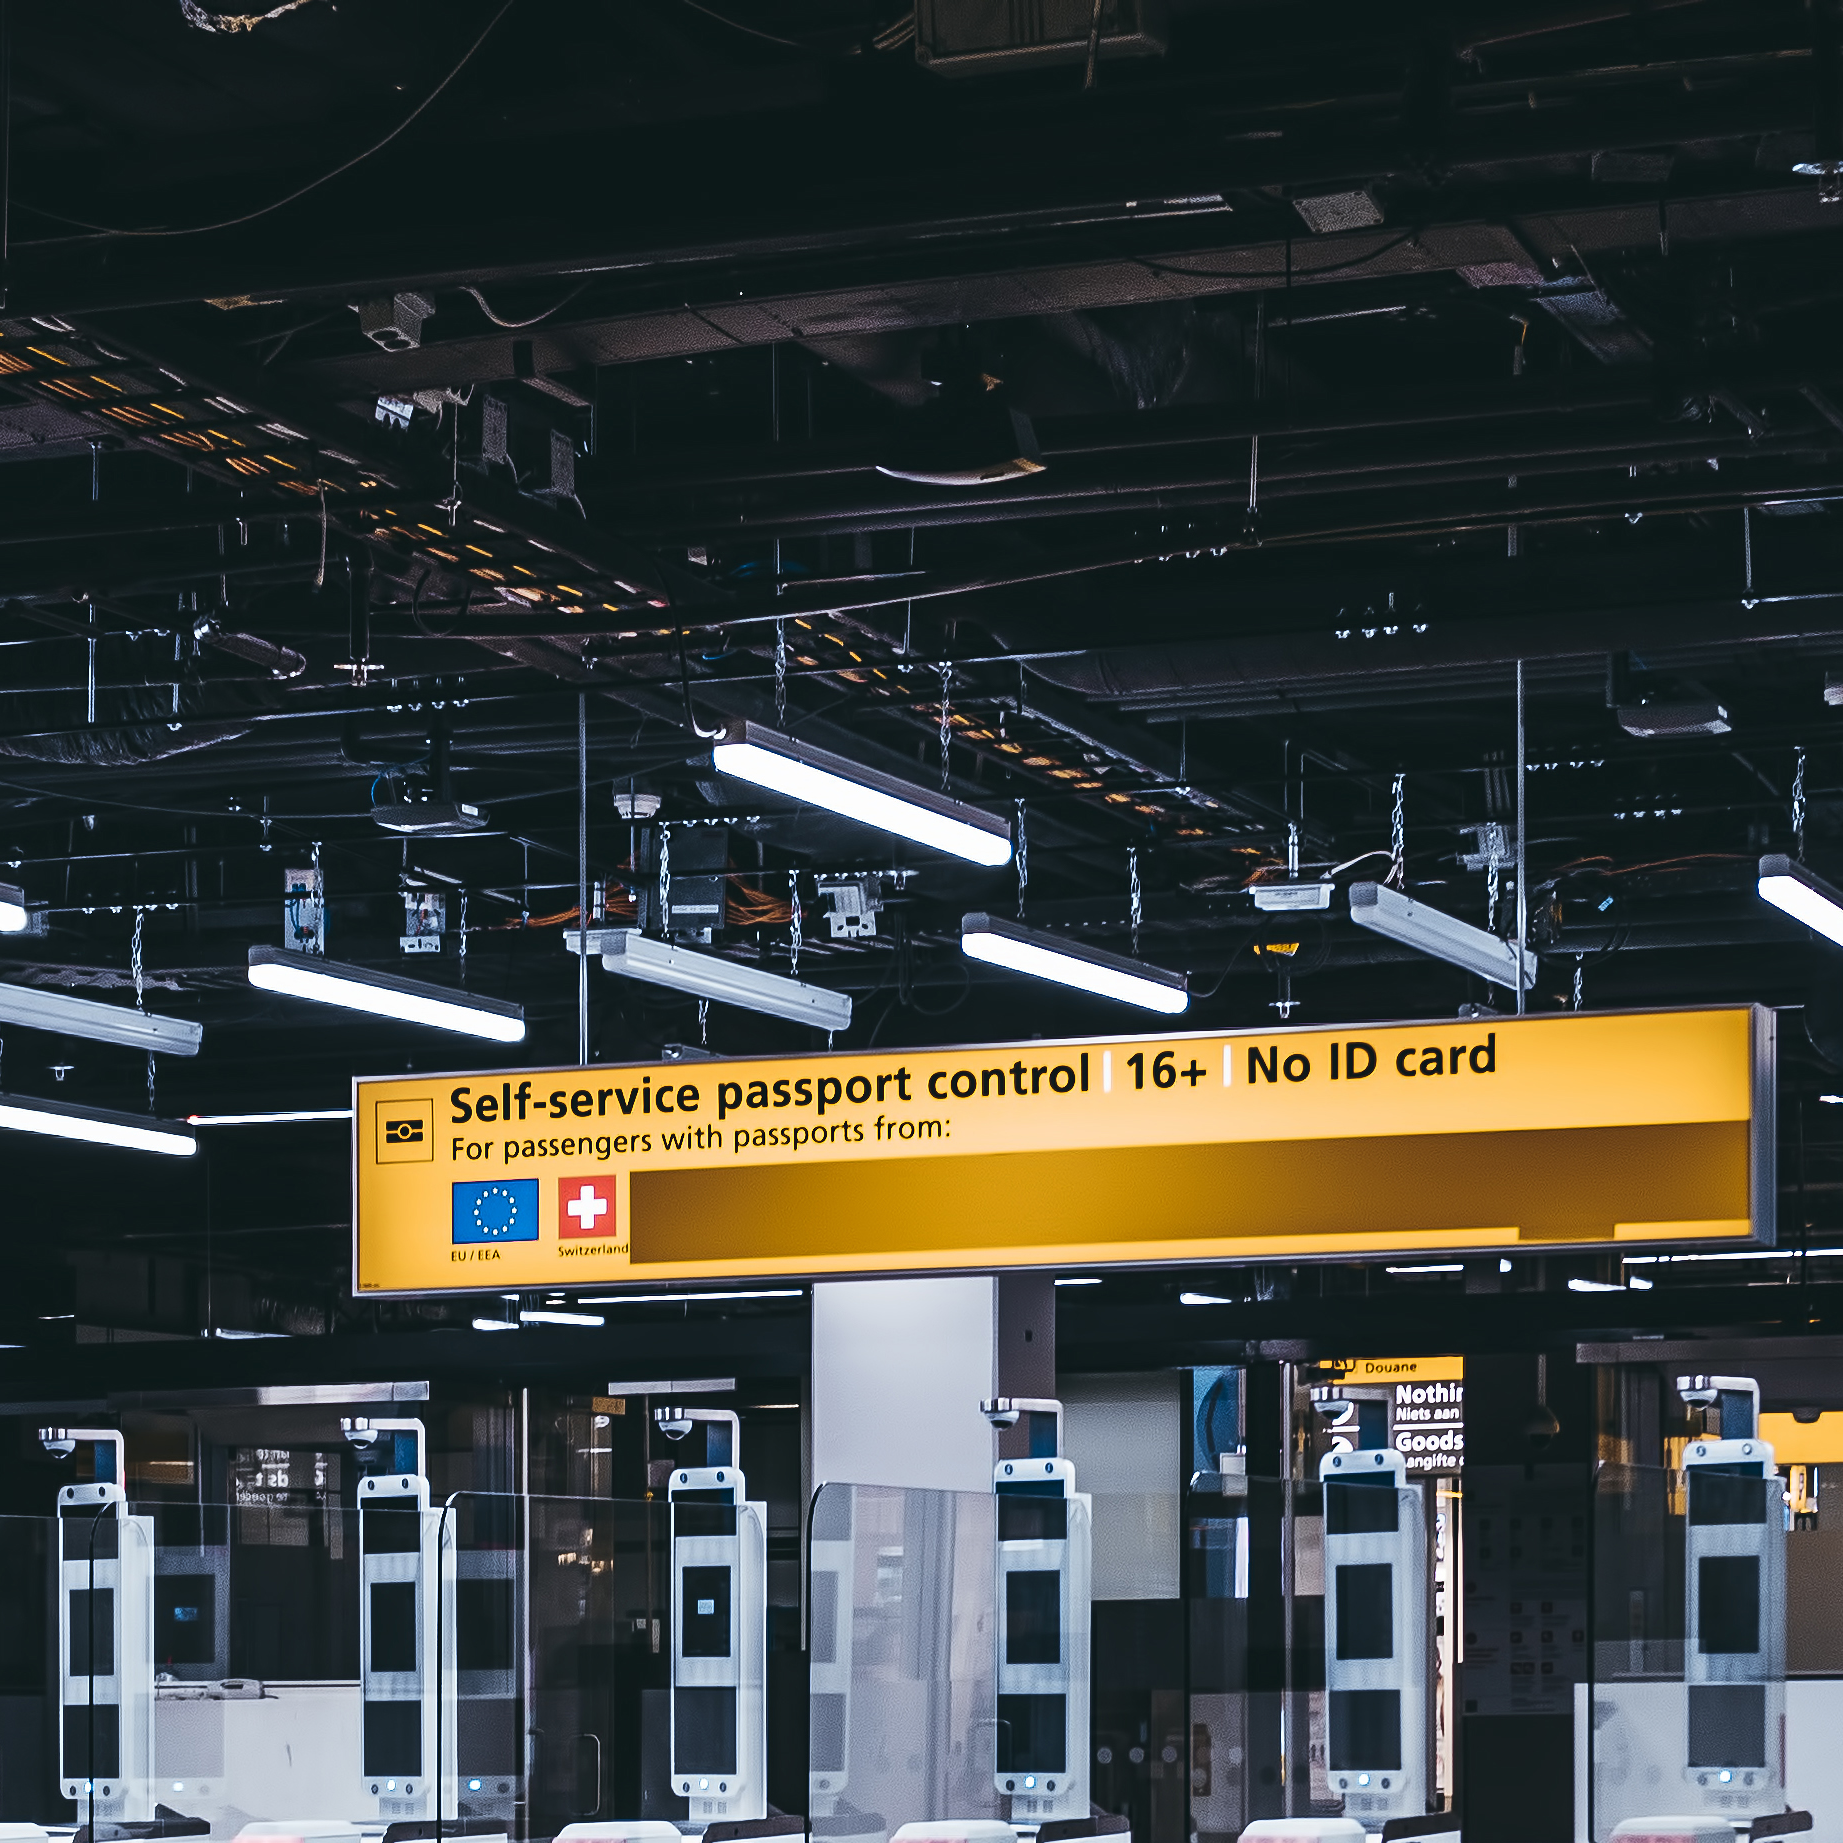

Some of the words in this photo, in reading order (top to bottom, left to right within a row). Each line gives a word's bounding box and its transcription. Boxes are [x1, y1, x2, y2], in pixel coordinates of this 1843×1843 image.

[450, 1076, 700, 1124] Self-service
[718, 1066, 912, 1119] passport
[927, 1052, 1090, 1100] control
[1125, 1051, 1207, 1089] 16+
[1247, 1044, 1311, 1085] No
[1329, 1040, 1378, 1080] ID
[1394, 1032, 1498, 1078] card
[451, 1135, 495, 1162] For
[504, 1129, 652, 1165] passengers
[661, 1122, 724, 1151] with
[733, 1120, 865, 1153] passports
[874, 1115, 951, 1141] from:
[451, 1250, 466, 1262] EU
[478, 1249, 501, 1261] EEA
[558, 1243, 630, 1258] Switzerland
[1365, 1362, 1417, 1374] Douane
[1396, 1407, 1431, 1421] Niets
[1434, 1408, 1460, 1419] aan
[1395, 1430, 1464, 1452] Goods
[1407, 1453, 1456, 1471] angifte
